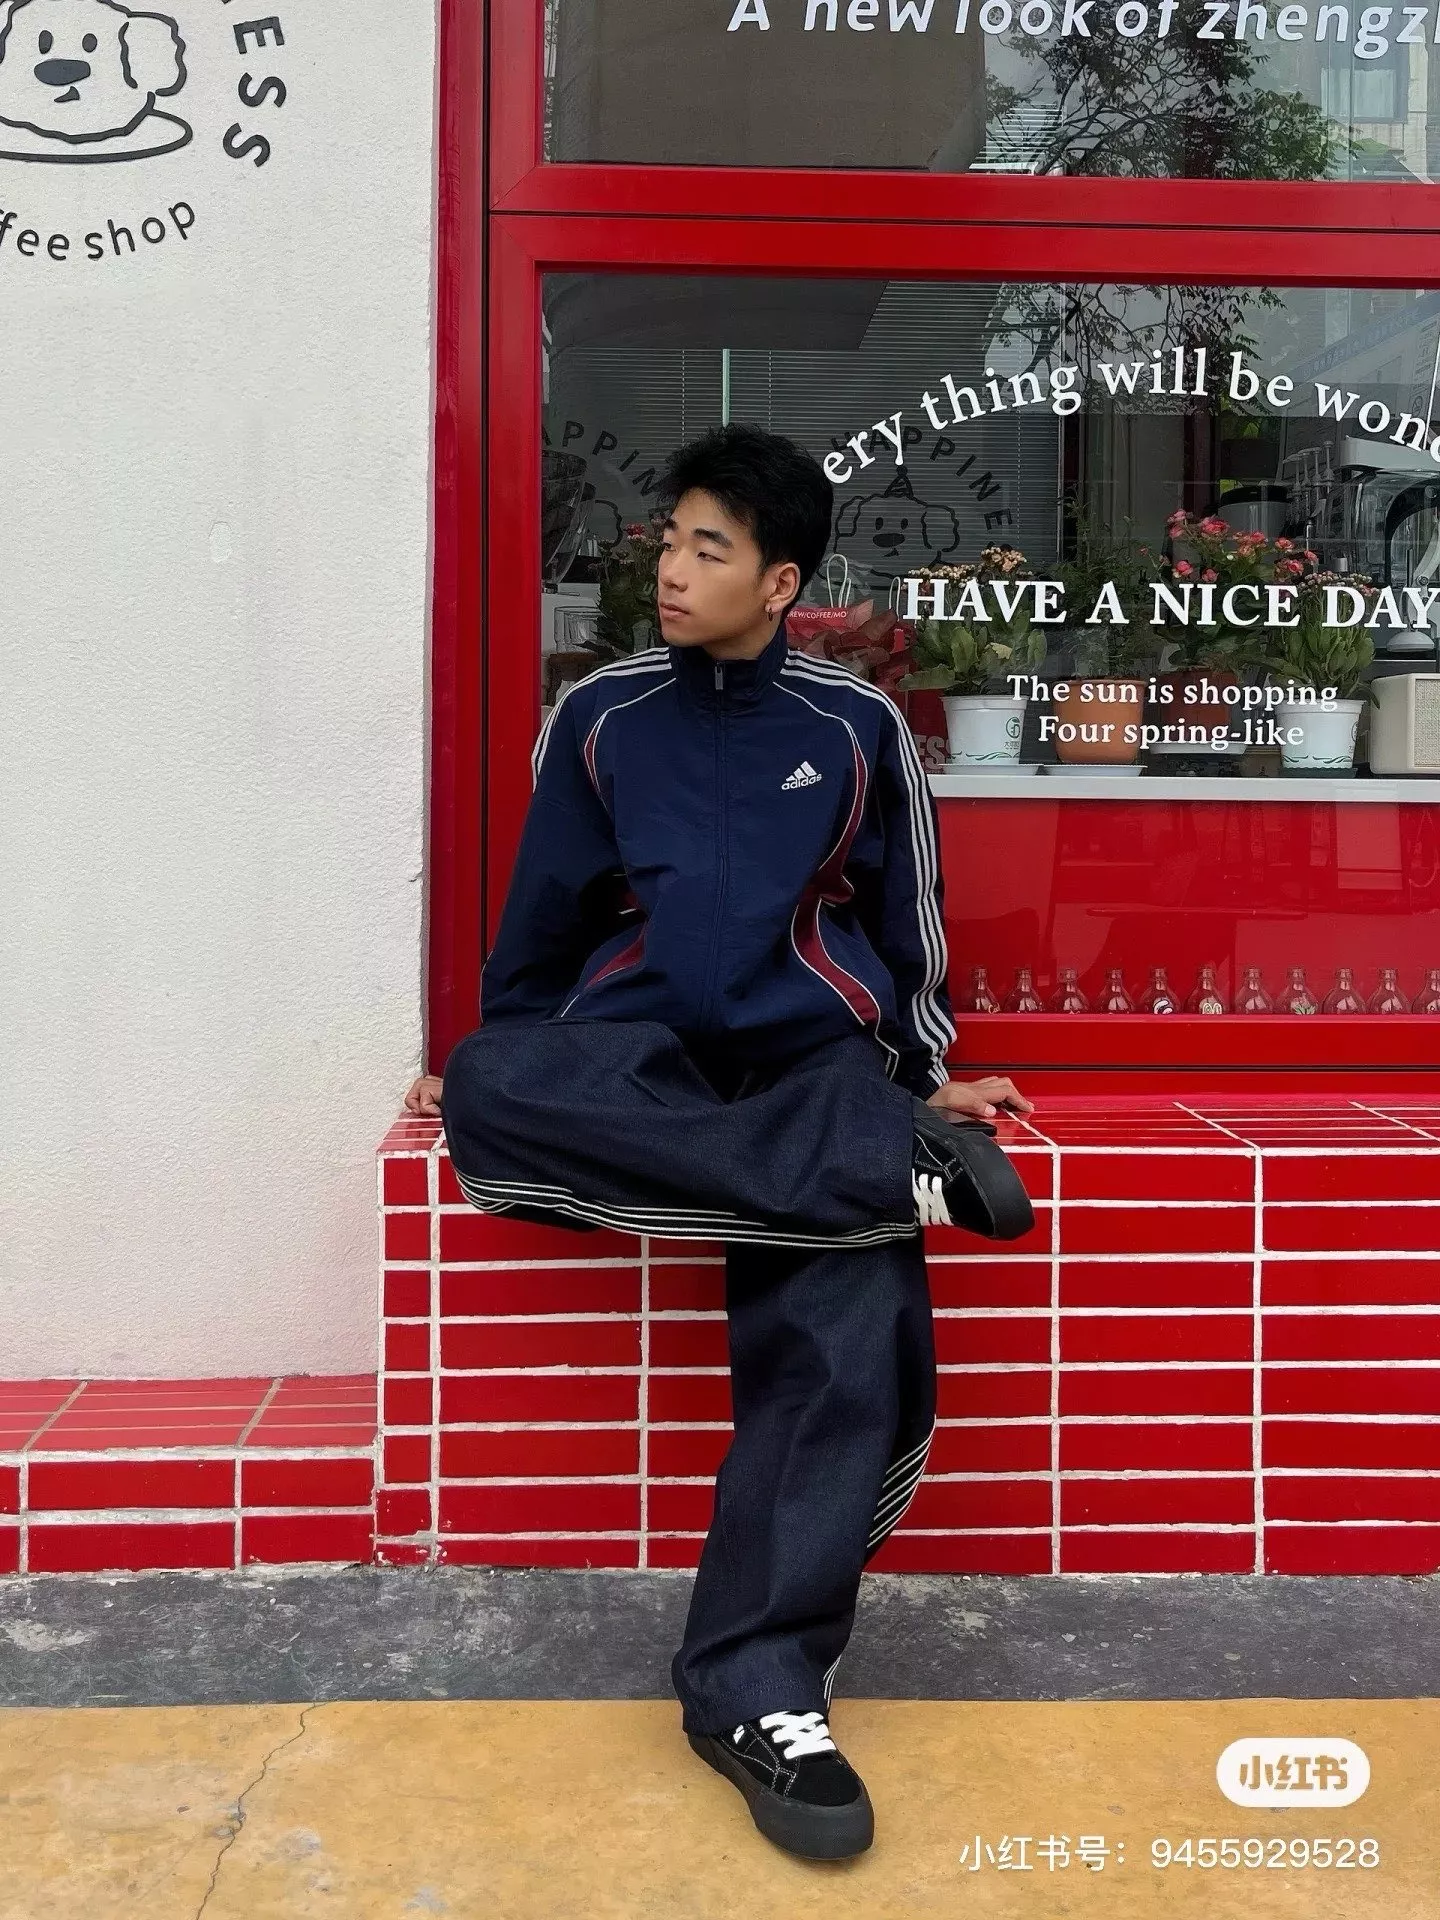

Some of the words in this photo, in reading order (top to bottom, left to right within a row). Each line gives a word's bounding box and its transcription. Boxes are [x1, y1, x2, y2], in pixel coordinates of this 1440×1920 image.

[726, 0, 770, 31] A
[804, 0, 935, 33] new
[955, 0, 1096, 36] look
[1115, 0, 1180, 38] of
[1196, 0, 1440, 60] zhengz
[223, 0, 287, 168] ESS
[0, 209, 70, 261] fee
[84, 201, 196, 261] shop
[920, 366, 1082, 430] thing
[1098, 345, 1208, 395] will
[1229, 351, 1302, 407] be
[902, 578, 1067, 624] HAVE
[1085, 580, 1130, 624] A
[1148, 583, 1301, 628] NICE
[1321, 585, 1440, 629] DAY
[1006, 674, 1070, 702] The
[1080, 683, 1139, 703] sun
[1148, 675, 1174, 704] is
[1183, 676, 1338, 712] shopping
[1038, 715, 1115, 743] Four
[1123, 717, 1305, 751] spring-like
[781, 773, 822, 790] adidas
